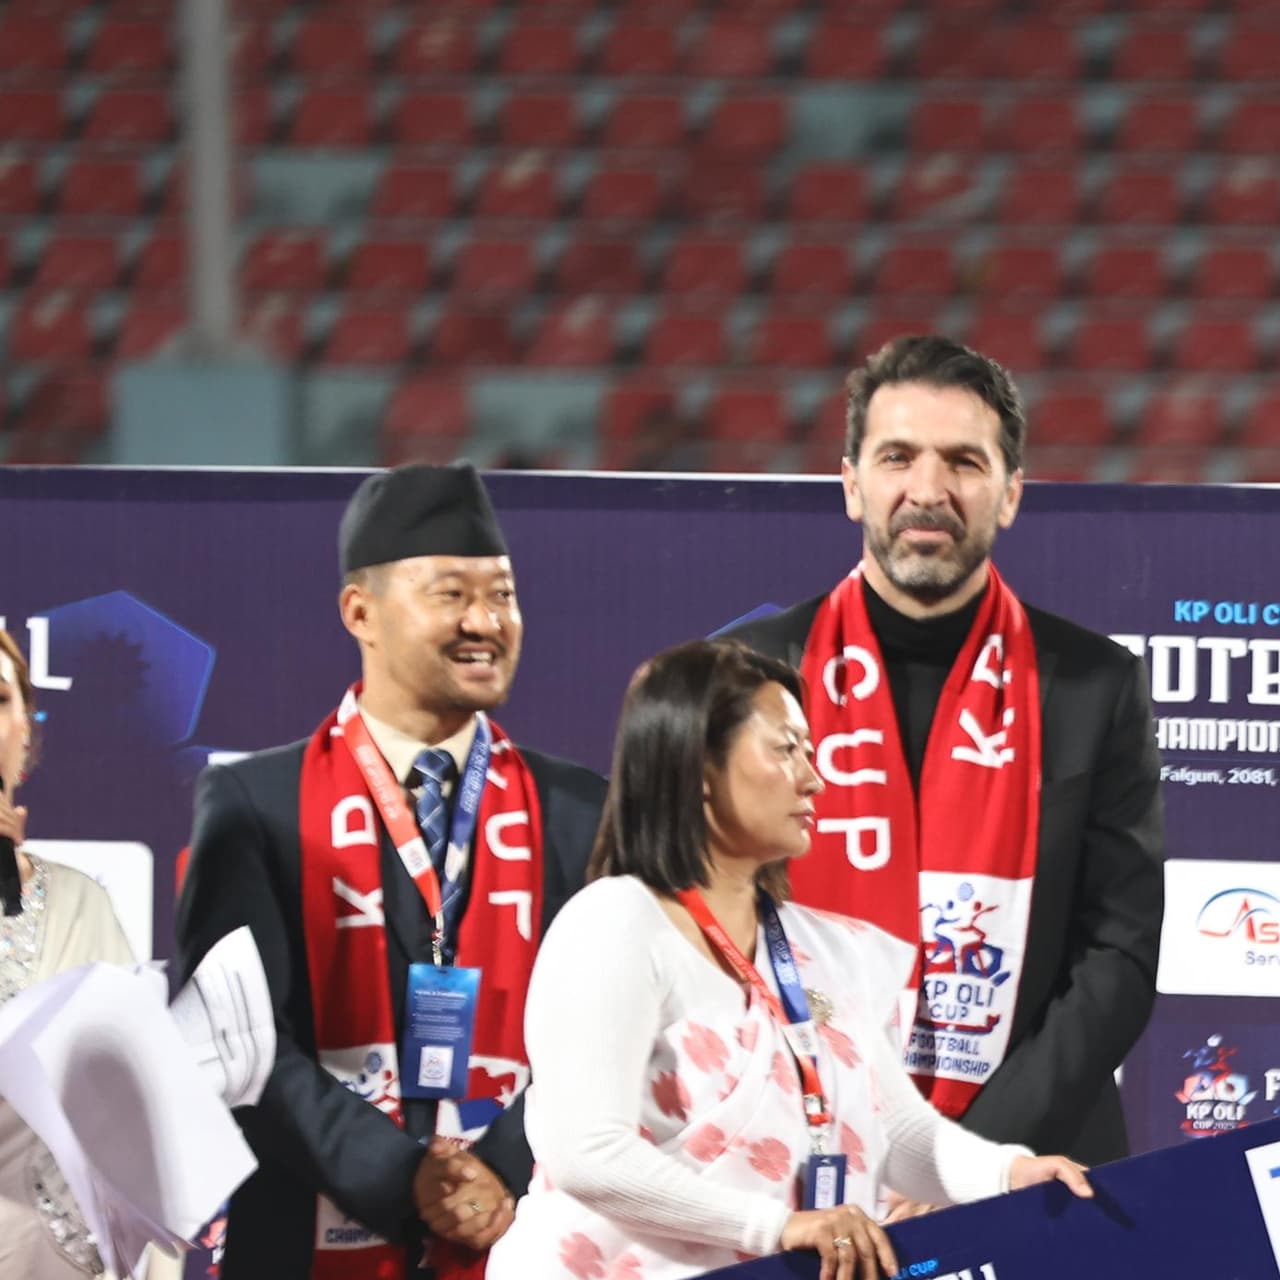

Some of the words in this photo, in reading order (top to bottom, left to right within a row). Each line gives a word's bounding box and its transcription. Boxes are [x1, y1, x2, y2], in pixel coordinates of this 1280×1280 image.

[1174, 600, 1210, 623] KP
[1215, 602, 1257, 625] OLI
[1160, 766, 1225, 786] Falgun,
[956, 982, 995, 1008] OLI
[929, 1003, 969, 1021] CUP
[1186, 1103, 1212, 1120] KP
[909, 1257, 940, 1277] CUP
